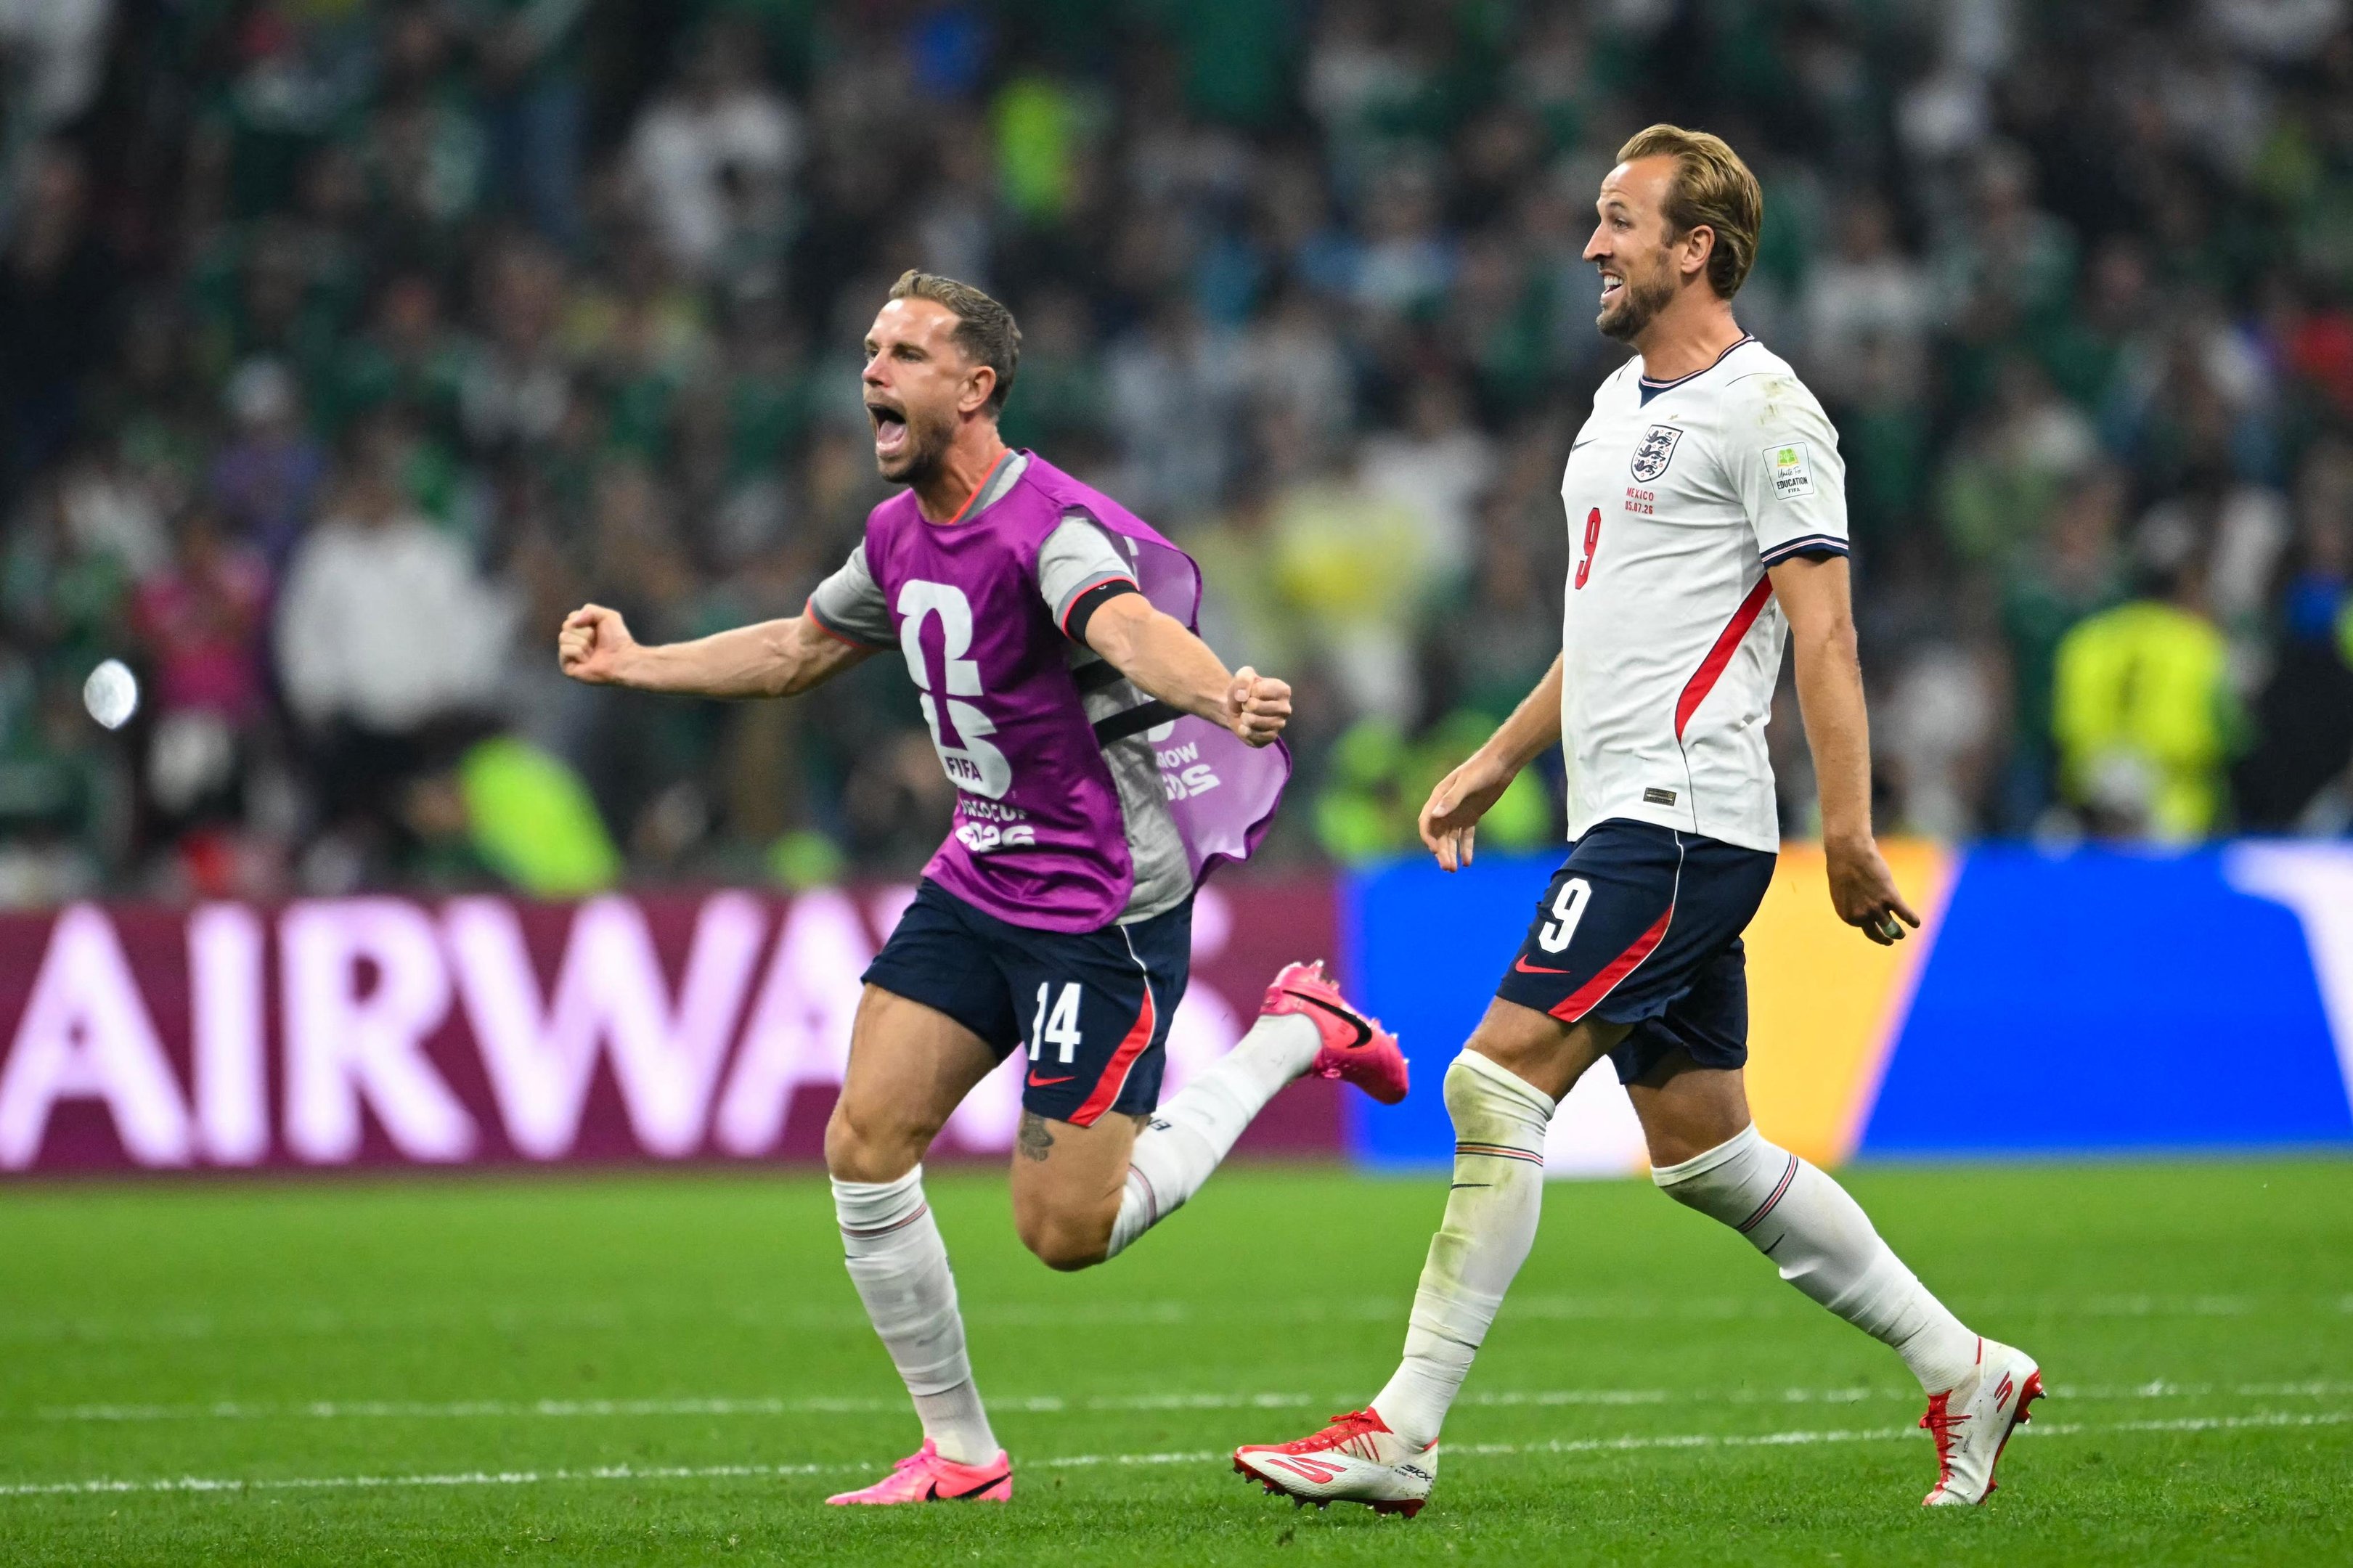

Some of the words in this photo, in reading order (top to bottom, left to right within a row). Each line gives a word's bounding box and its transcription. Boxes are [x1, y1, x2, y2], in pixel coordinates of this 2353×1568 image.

[1626, 486, 1654, 501] MEXICO
[1776, 476, 1809, 490] EDUCATION
[1625, 500, 1654, 515] 05.07.26
[1575, 507, 1602, 590] 9
[944, 756, 983, 783] FIFA
[1538, 877, 1593, 954] 9
[1028, 981, 1082, 1063] 14
